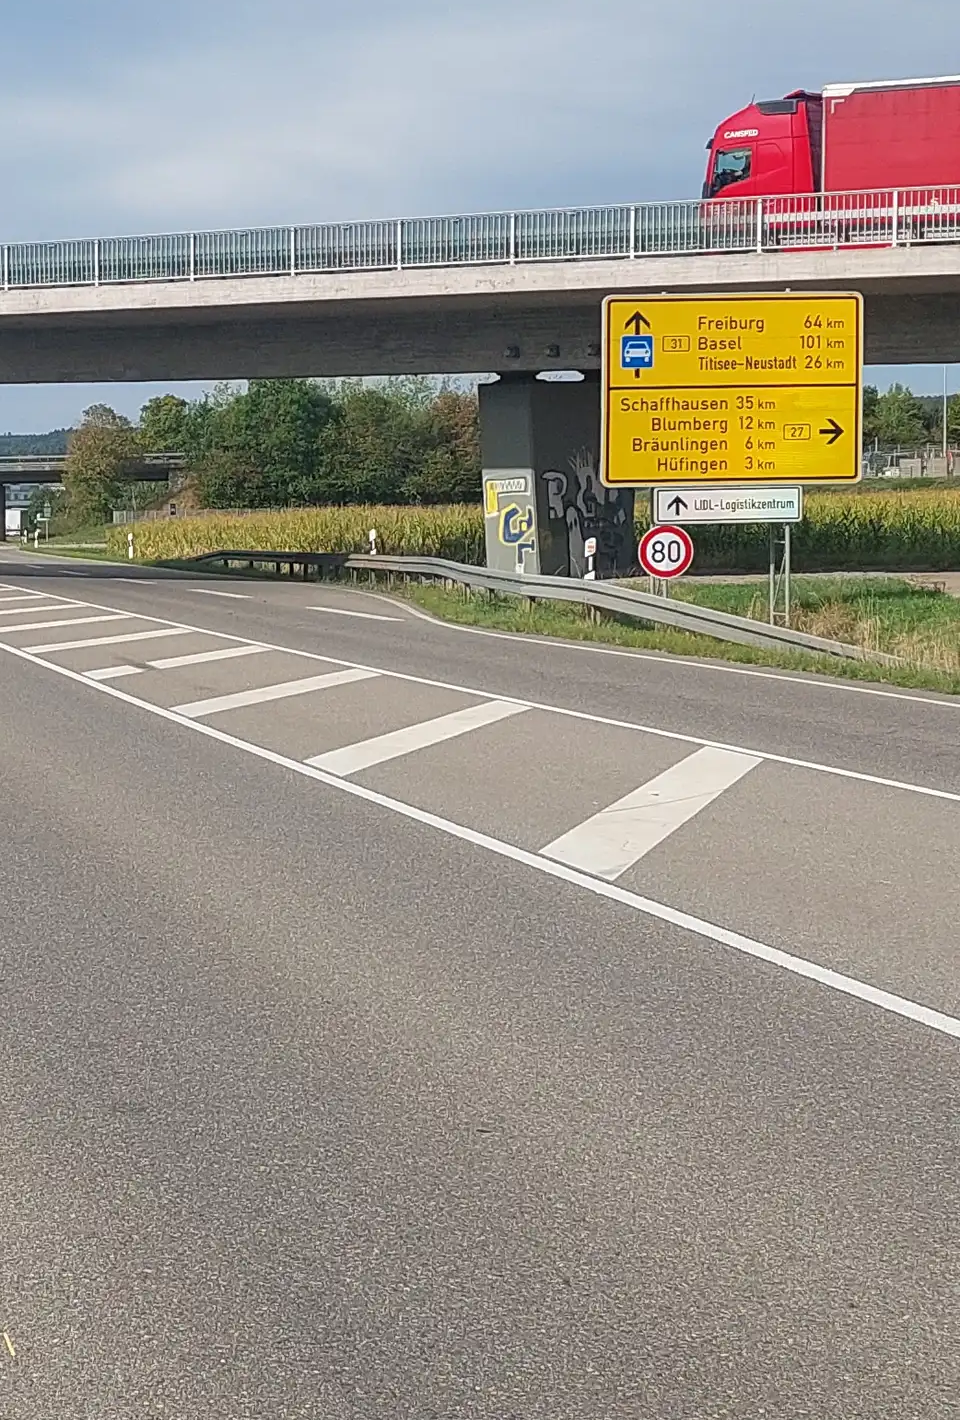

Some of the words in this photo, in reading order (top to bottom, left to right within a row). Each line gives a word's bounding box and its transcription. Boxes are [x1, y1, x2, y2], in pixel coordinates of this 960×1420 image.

[698, 316, 765, 332] Freiburg
[804, 315, 823, 329] 64
[826, 318, 845, 329] km
[670, 339, 684, 350] 31
[698, 336, 742, 350] Basel
[800, 335, 822, 349] 101
[826, 338, 845, 349] km
[698, 355, 797, 370] Titisee-Neustadt
[804, 355, 823, 369] 26
[826, 358, 845, 369] km
[620, 396, 729, 412] Schaffhausen
[736, 396, 754, 410] 35
[757, 399, 776, 410] km
[651, 417, 728, 433] Blumberg
[739, 416, 754, 430] 12
[757, 419, 776, 430] km
[790, 427, 804, 438] 27
[632, 437, 728, 454] Bräunlingen
[744, 436, 754, 450] 6
[757, 440, 776, 450] km
[657, 457, 728, 474] Hüfingen
[744, 456, 754, 470] 3
[757, 459, 776, 470] km
[694, 498, 795, 512] LIDL-Logistikzentrum
[651, 540, 681, 563] 80
